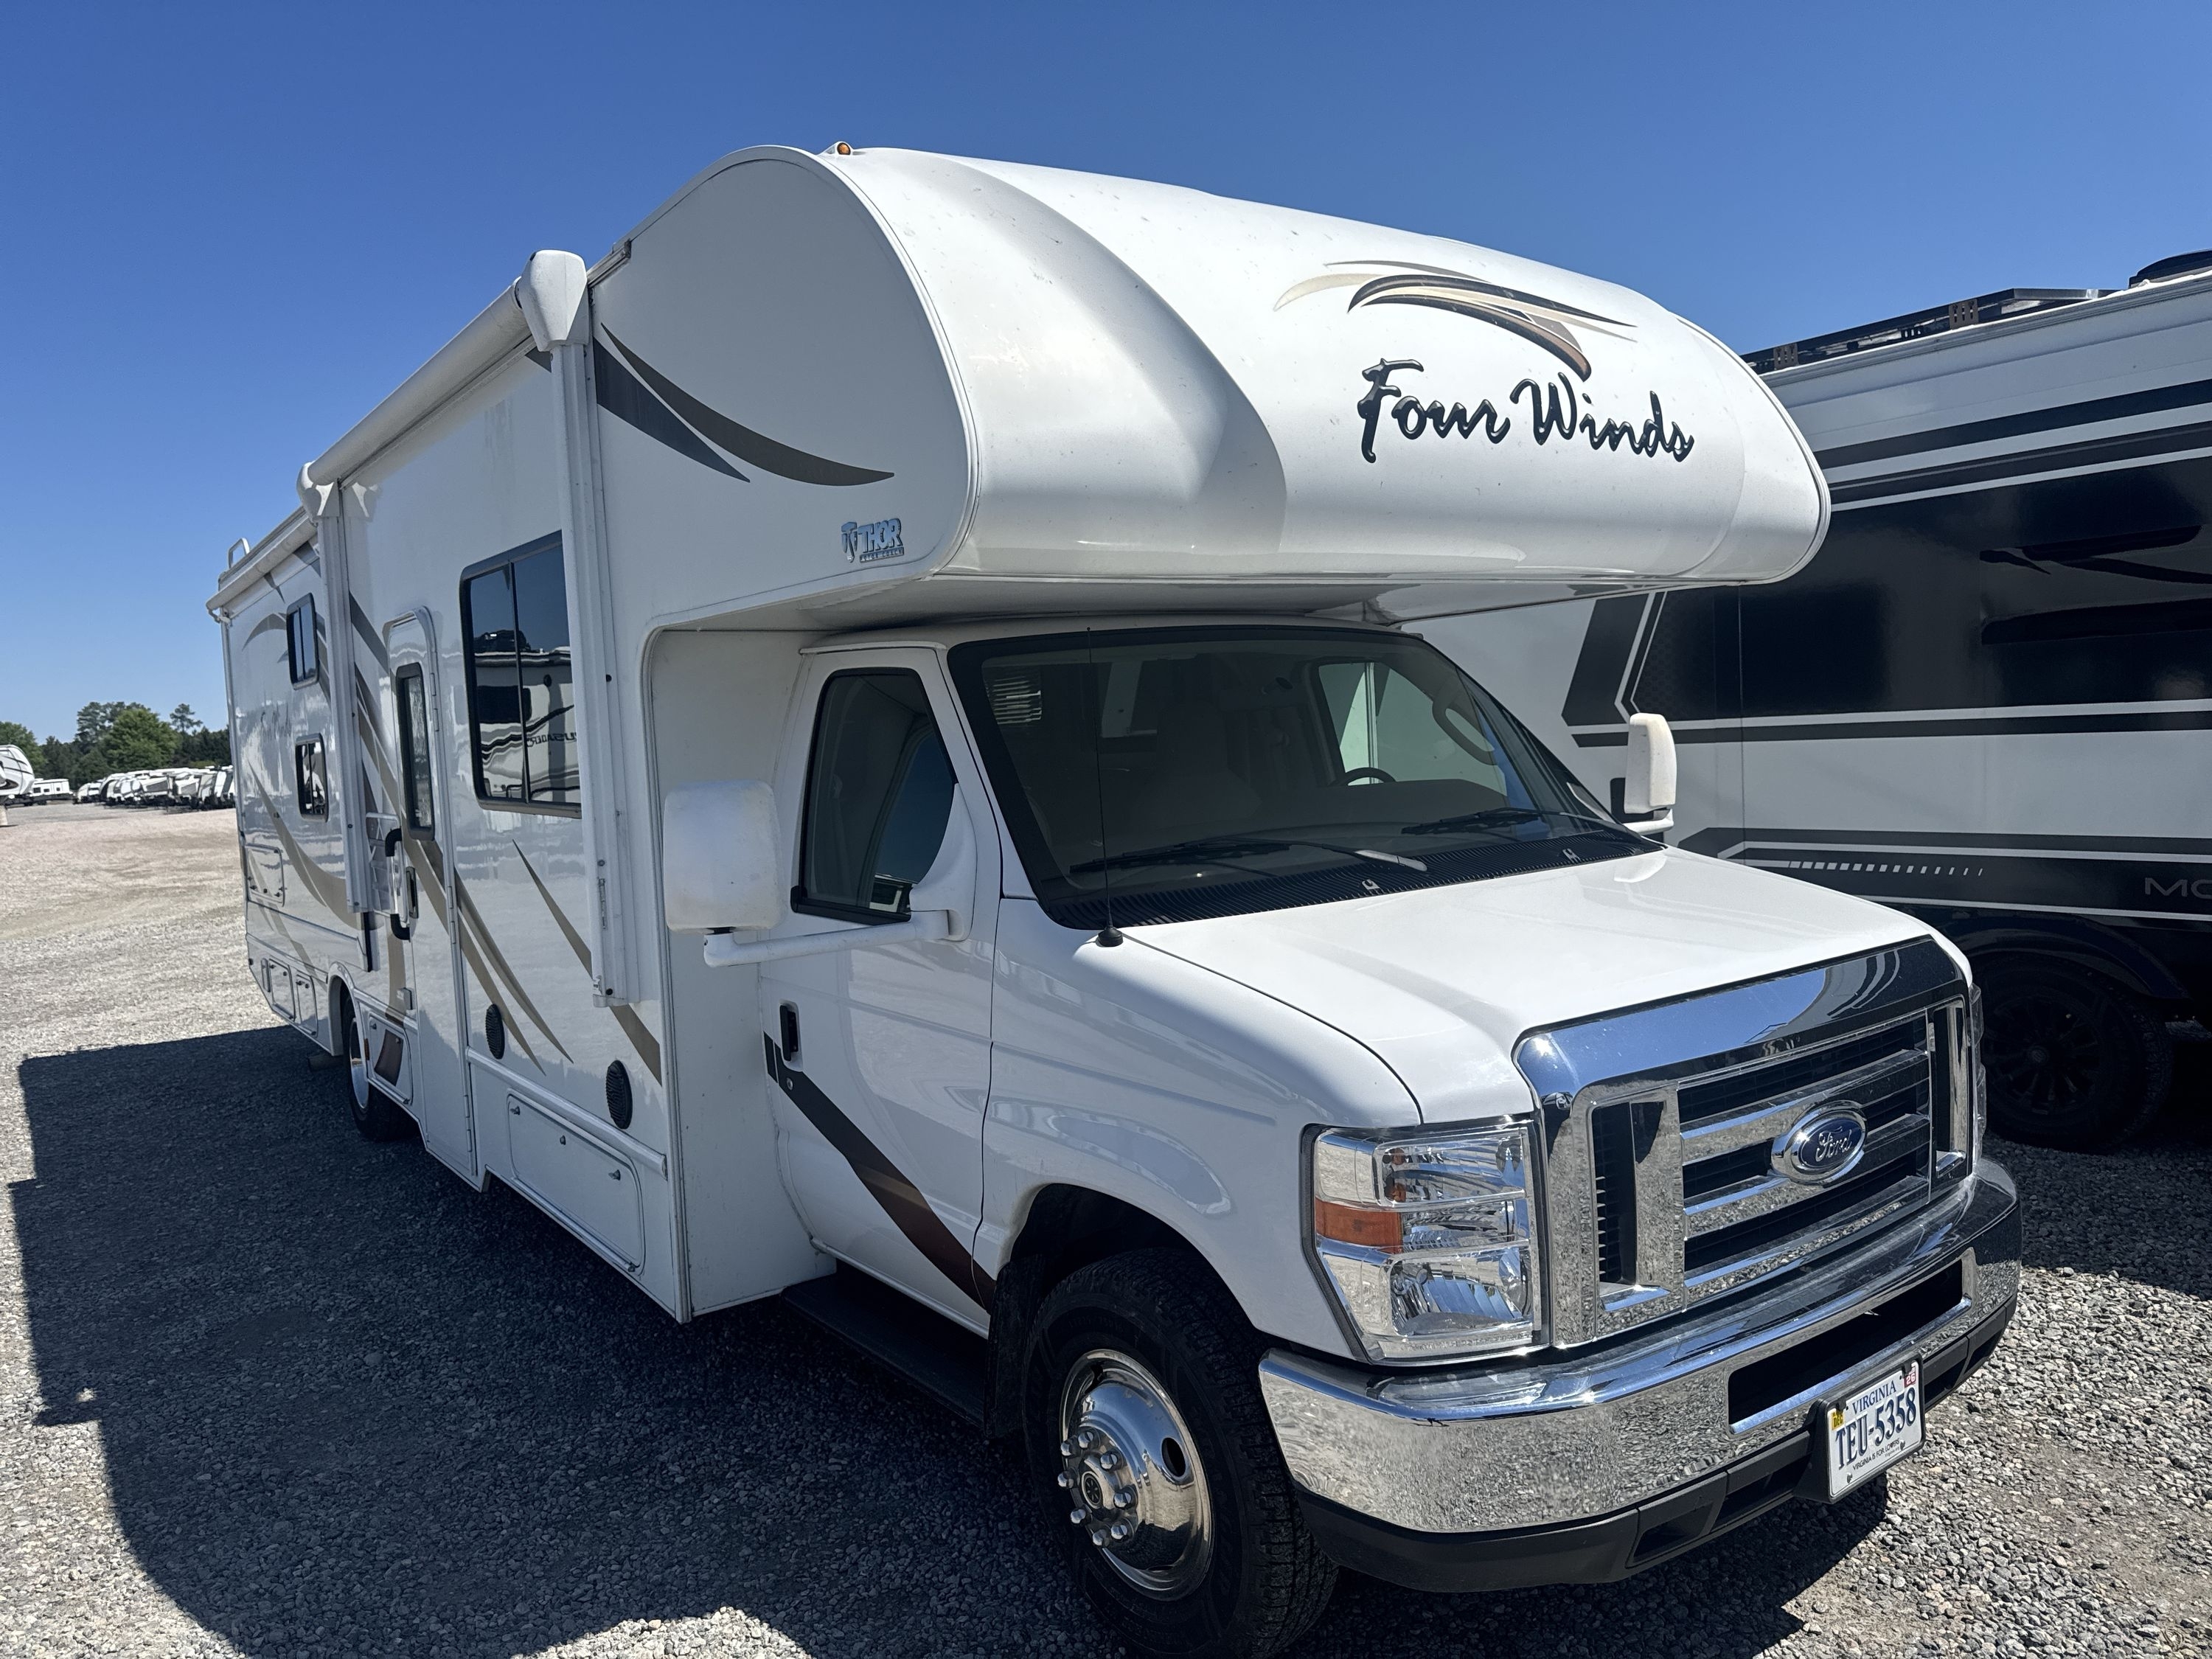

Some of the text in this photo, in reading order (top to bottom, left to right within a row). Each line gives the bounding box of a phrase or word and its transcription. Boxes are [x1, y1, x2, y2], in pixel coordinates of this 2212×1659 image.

[1357, 358, 1695, 463] Four Winds
[858, 518, 904, 553] THOR
[1815, 1126, 1852, 1162] Ford
[1906, 1373, 1916, 1385] 26
[1851, 1380, 1896, 1414] VIRGINIA
[1835, 1387, 1917, 1470] TEU-5358
[1852, 1456, 1872, 1470] VIRGINIA
[1876, 1447, 1885, 1458] FOR
